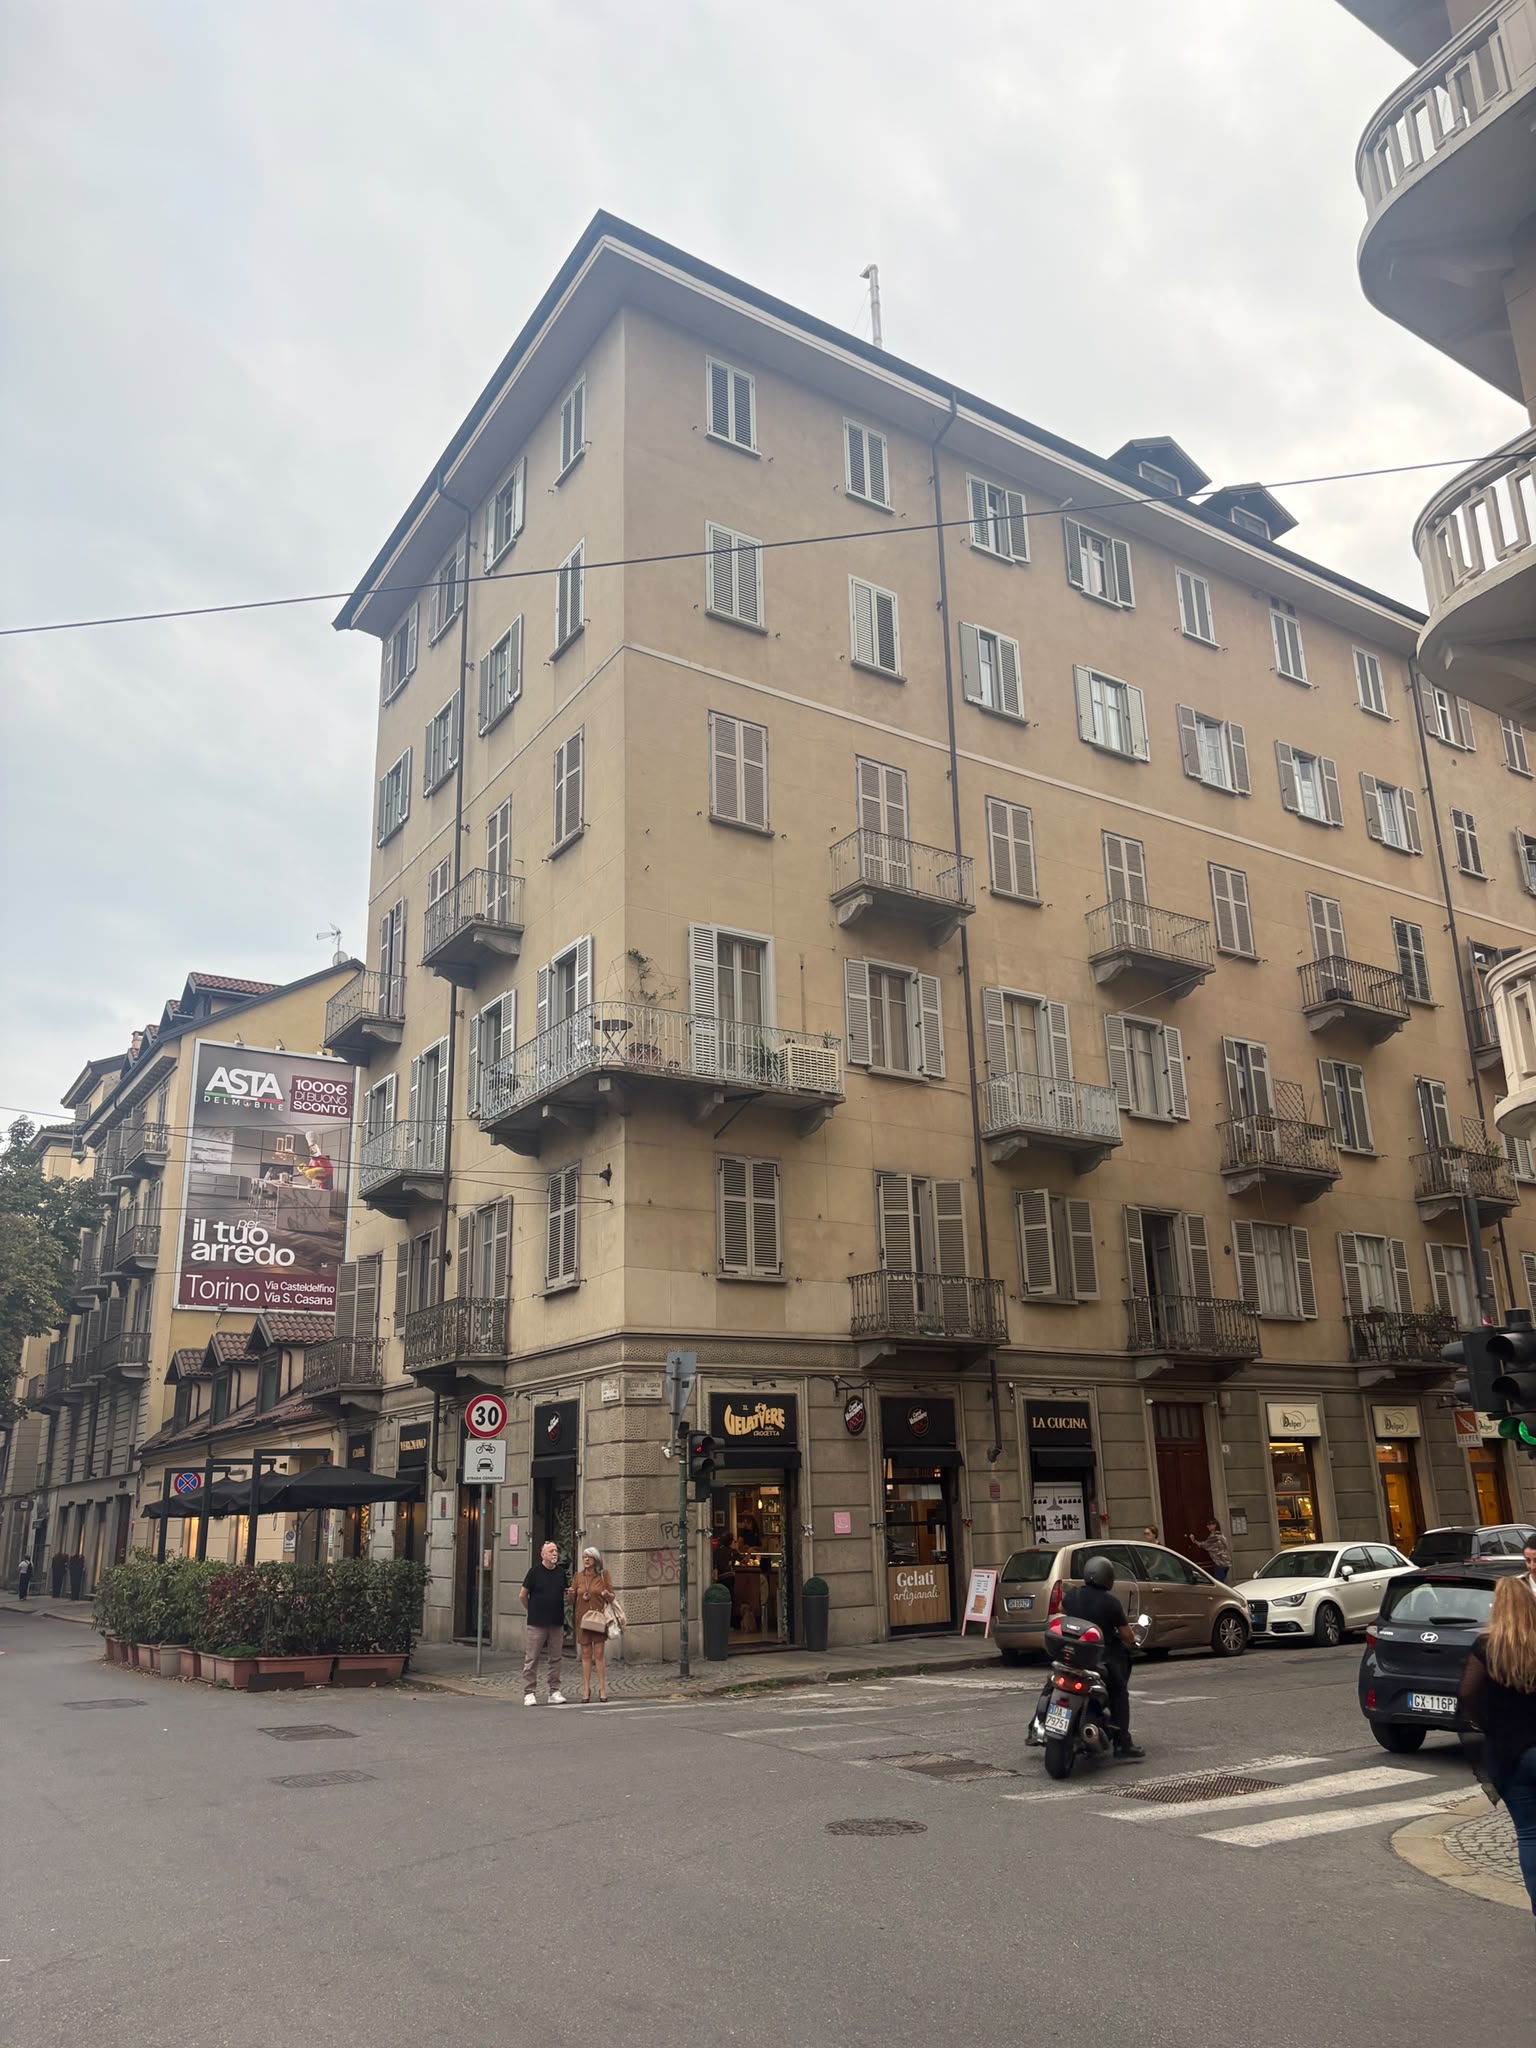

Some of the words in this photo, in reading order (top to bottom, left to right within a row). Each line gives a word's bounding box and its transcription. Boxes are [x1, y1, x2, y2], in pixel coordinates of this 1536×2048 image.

[205, 1067, 283, 1100] ASTA
[296, 1079, 347, 1095] 1000€
[295, 1091, 306, 1099] DI
[307, 1092, 347, 1106] BUONO
[293, 1101, 348, 1115] SCONTO
[193, 1218, 206, 1241] il
[213, 1221, 268, 1245] tuo
[236, 1219, 260, 1231] per
[191, 1242, 295, 1266] arredo
[186, 1274, 260, 1302] Torino
[265, 1281, 279, 1291] Via
[280, 1281, 335, 1293] Casteldelfino
[264, 1292, 280, 1304] Via
[282, 1294, 292, 1304] S.
[295, 1294, 333, 1306] Casana
[475, 1406, 499, 1427] 30
[1032, 1417, 1045, 1428] LA
[1047, 1417, 1088, 1429] CUCINA
[897, 1570, 934, 1587] Gelati
[893, 1585, 938, 1606] artigianali
[1414, 1695, 1426, 1708] GX
[1046, 1715, 1068, 1730] 79751
